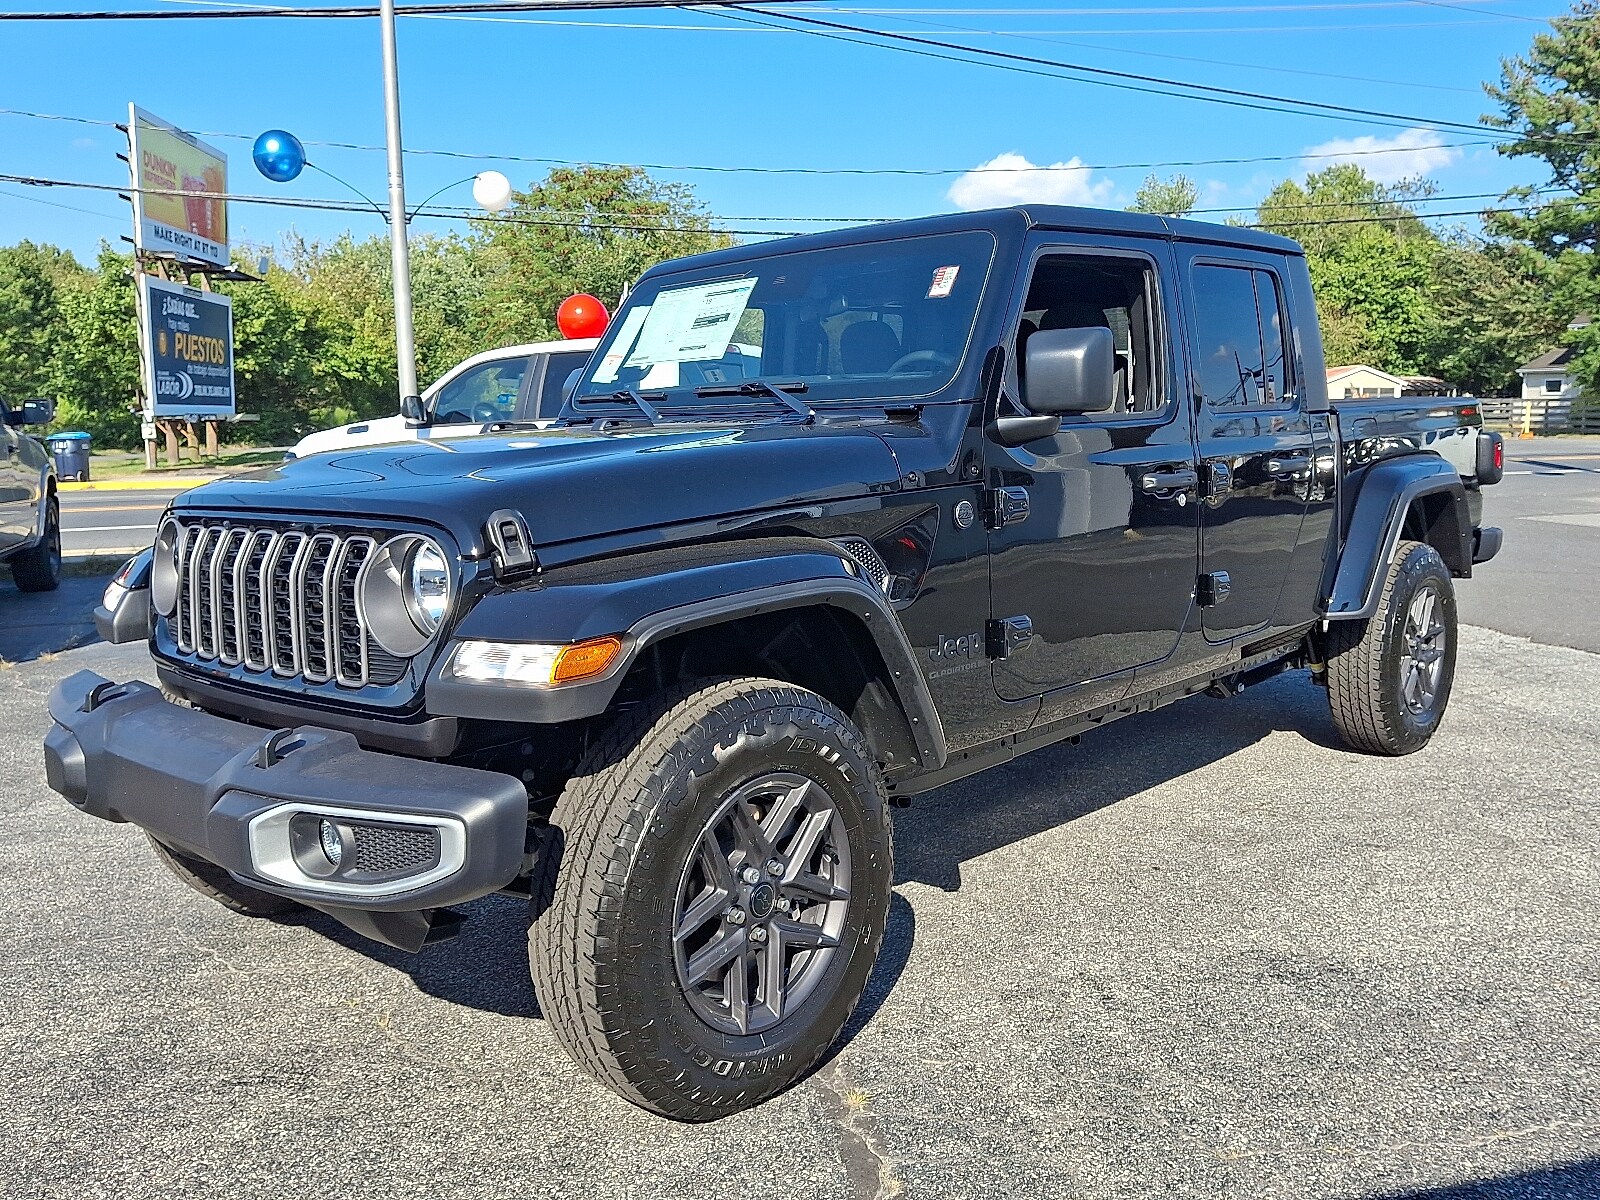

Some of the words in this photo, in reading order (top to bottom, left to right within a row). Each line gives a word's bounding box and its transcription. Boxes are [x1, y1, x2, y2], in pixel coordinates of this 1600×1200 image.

[154, 225, 173, 243] MAKE
[174, 232, 193, 249] RIGHT
[174, 332, 225, 365] PUESTOS
[157, 381, 180, 395] LABOR
[928, 632, 981, 662] Jeep
[928, 662, 977, 680] GLADIATOR
